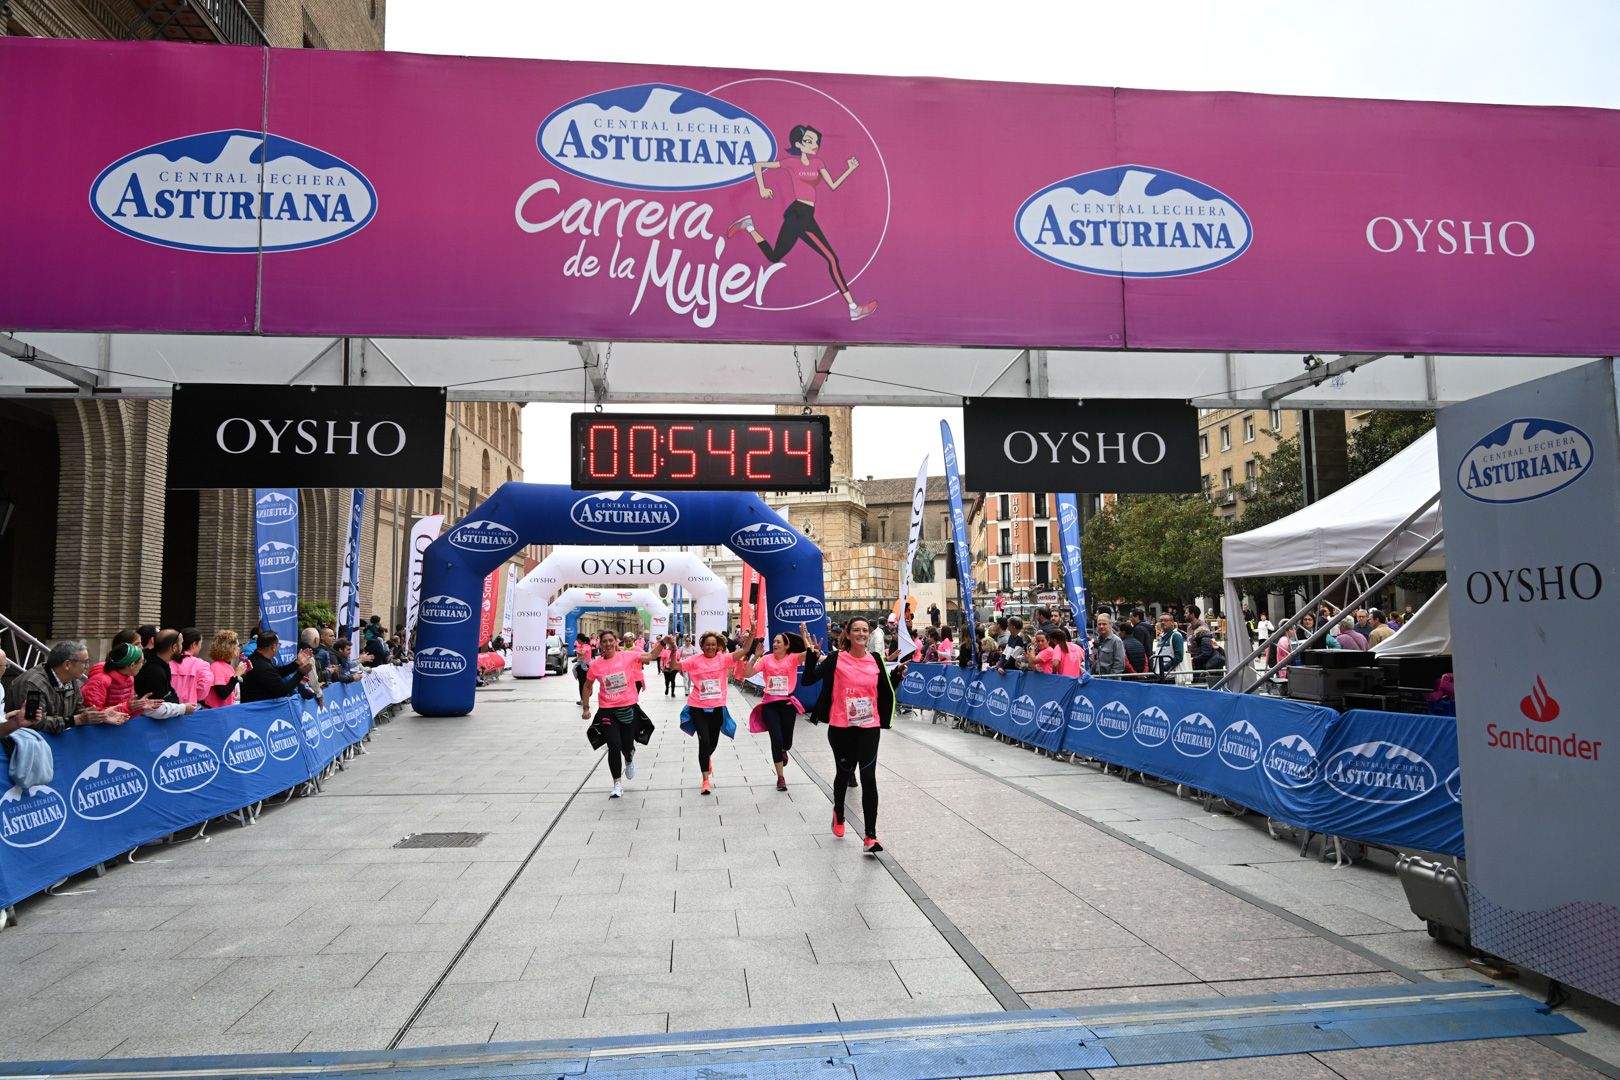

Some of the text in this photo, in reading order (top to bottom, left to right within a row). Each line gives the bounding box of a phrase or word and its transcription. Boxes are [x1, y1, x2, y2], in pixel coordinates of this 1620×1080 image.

[594, 118, 750, 134] CENTRAL LECHERA
[556, 119, 758, 166] ASTURIANA
[159, 171, 346, 186] CENTRAL LECHERA
[112, 172, 355, 222] ASTURIANA
[514, 178, 714, 241] Carrera
[1071, 203, 1226, 217] CENTRAL LECHERA
[1034, 204, 1236, 248] ASTURIANA
[1366, 216, 1535, 257] OYSHO
[563, 237, 786, 328] de la Mujer
[216, 418, 406, 457] OYSHO
[1004, 430, 1166, 464] OYSHO
[1482, 436, 1575, 462] CENTRAL LECHERA
[1466, 448, 1582, 490] ASTURIANA
[578, 503, 672, 524] ASTURIANA
[452, 530, 512, 544] ASTURIANA
[736, 534, 793, 546] ASTURIANA
[581, 558, 665, 576] OYSHO
[1466, 562, 1602, 604] OYSHO
[421, 606, 468, 618] ASTURIANA
[416, 657, 462, 670] ASTURIANA
[1134, 718, 1166, 739] ASTURIANA
[1174, 726, 1212, 748] ASTURIANA
[1487, 724, 1602, 760] Santander
[228, 746, 265, 766] ASTURIANA
[159, 758, 216, 786] ASTURIANA
[1329, 760, 1426, 792] ASTURIANA
[78, 778, 144, 812] ASTURIANA
[2, 804, 64, 838] ASTURIANA
